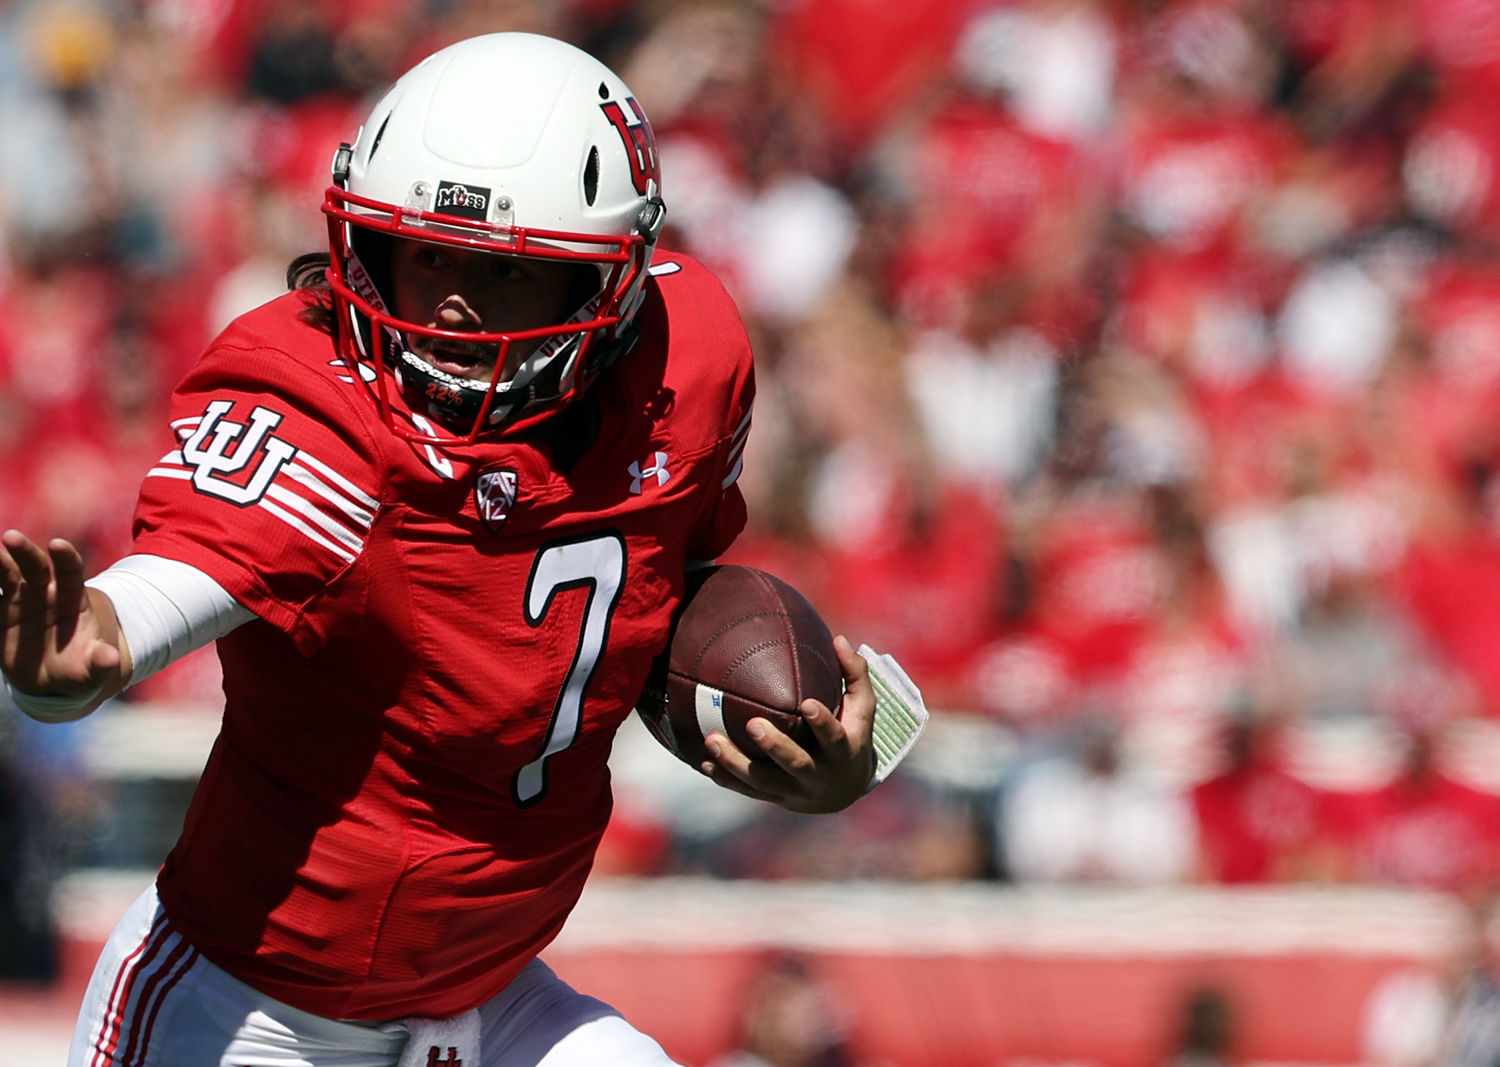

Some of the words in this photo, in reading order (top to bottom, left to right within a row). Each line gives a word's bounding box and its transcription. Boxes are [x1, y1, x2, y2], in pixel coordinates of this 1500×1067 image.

[425, 382, 463, 405] 22%
[486, 497, 507, 521] 12
[512, 527, 628, 809] 7
